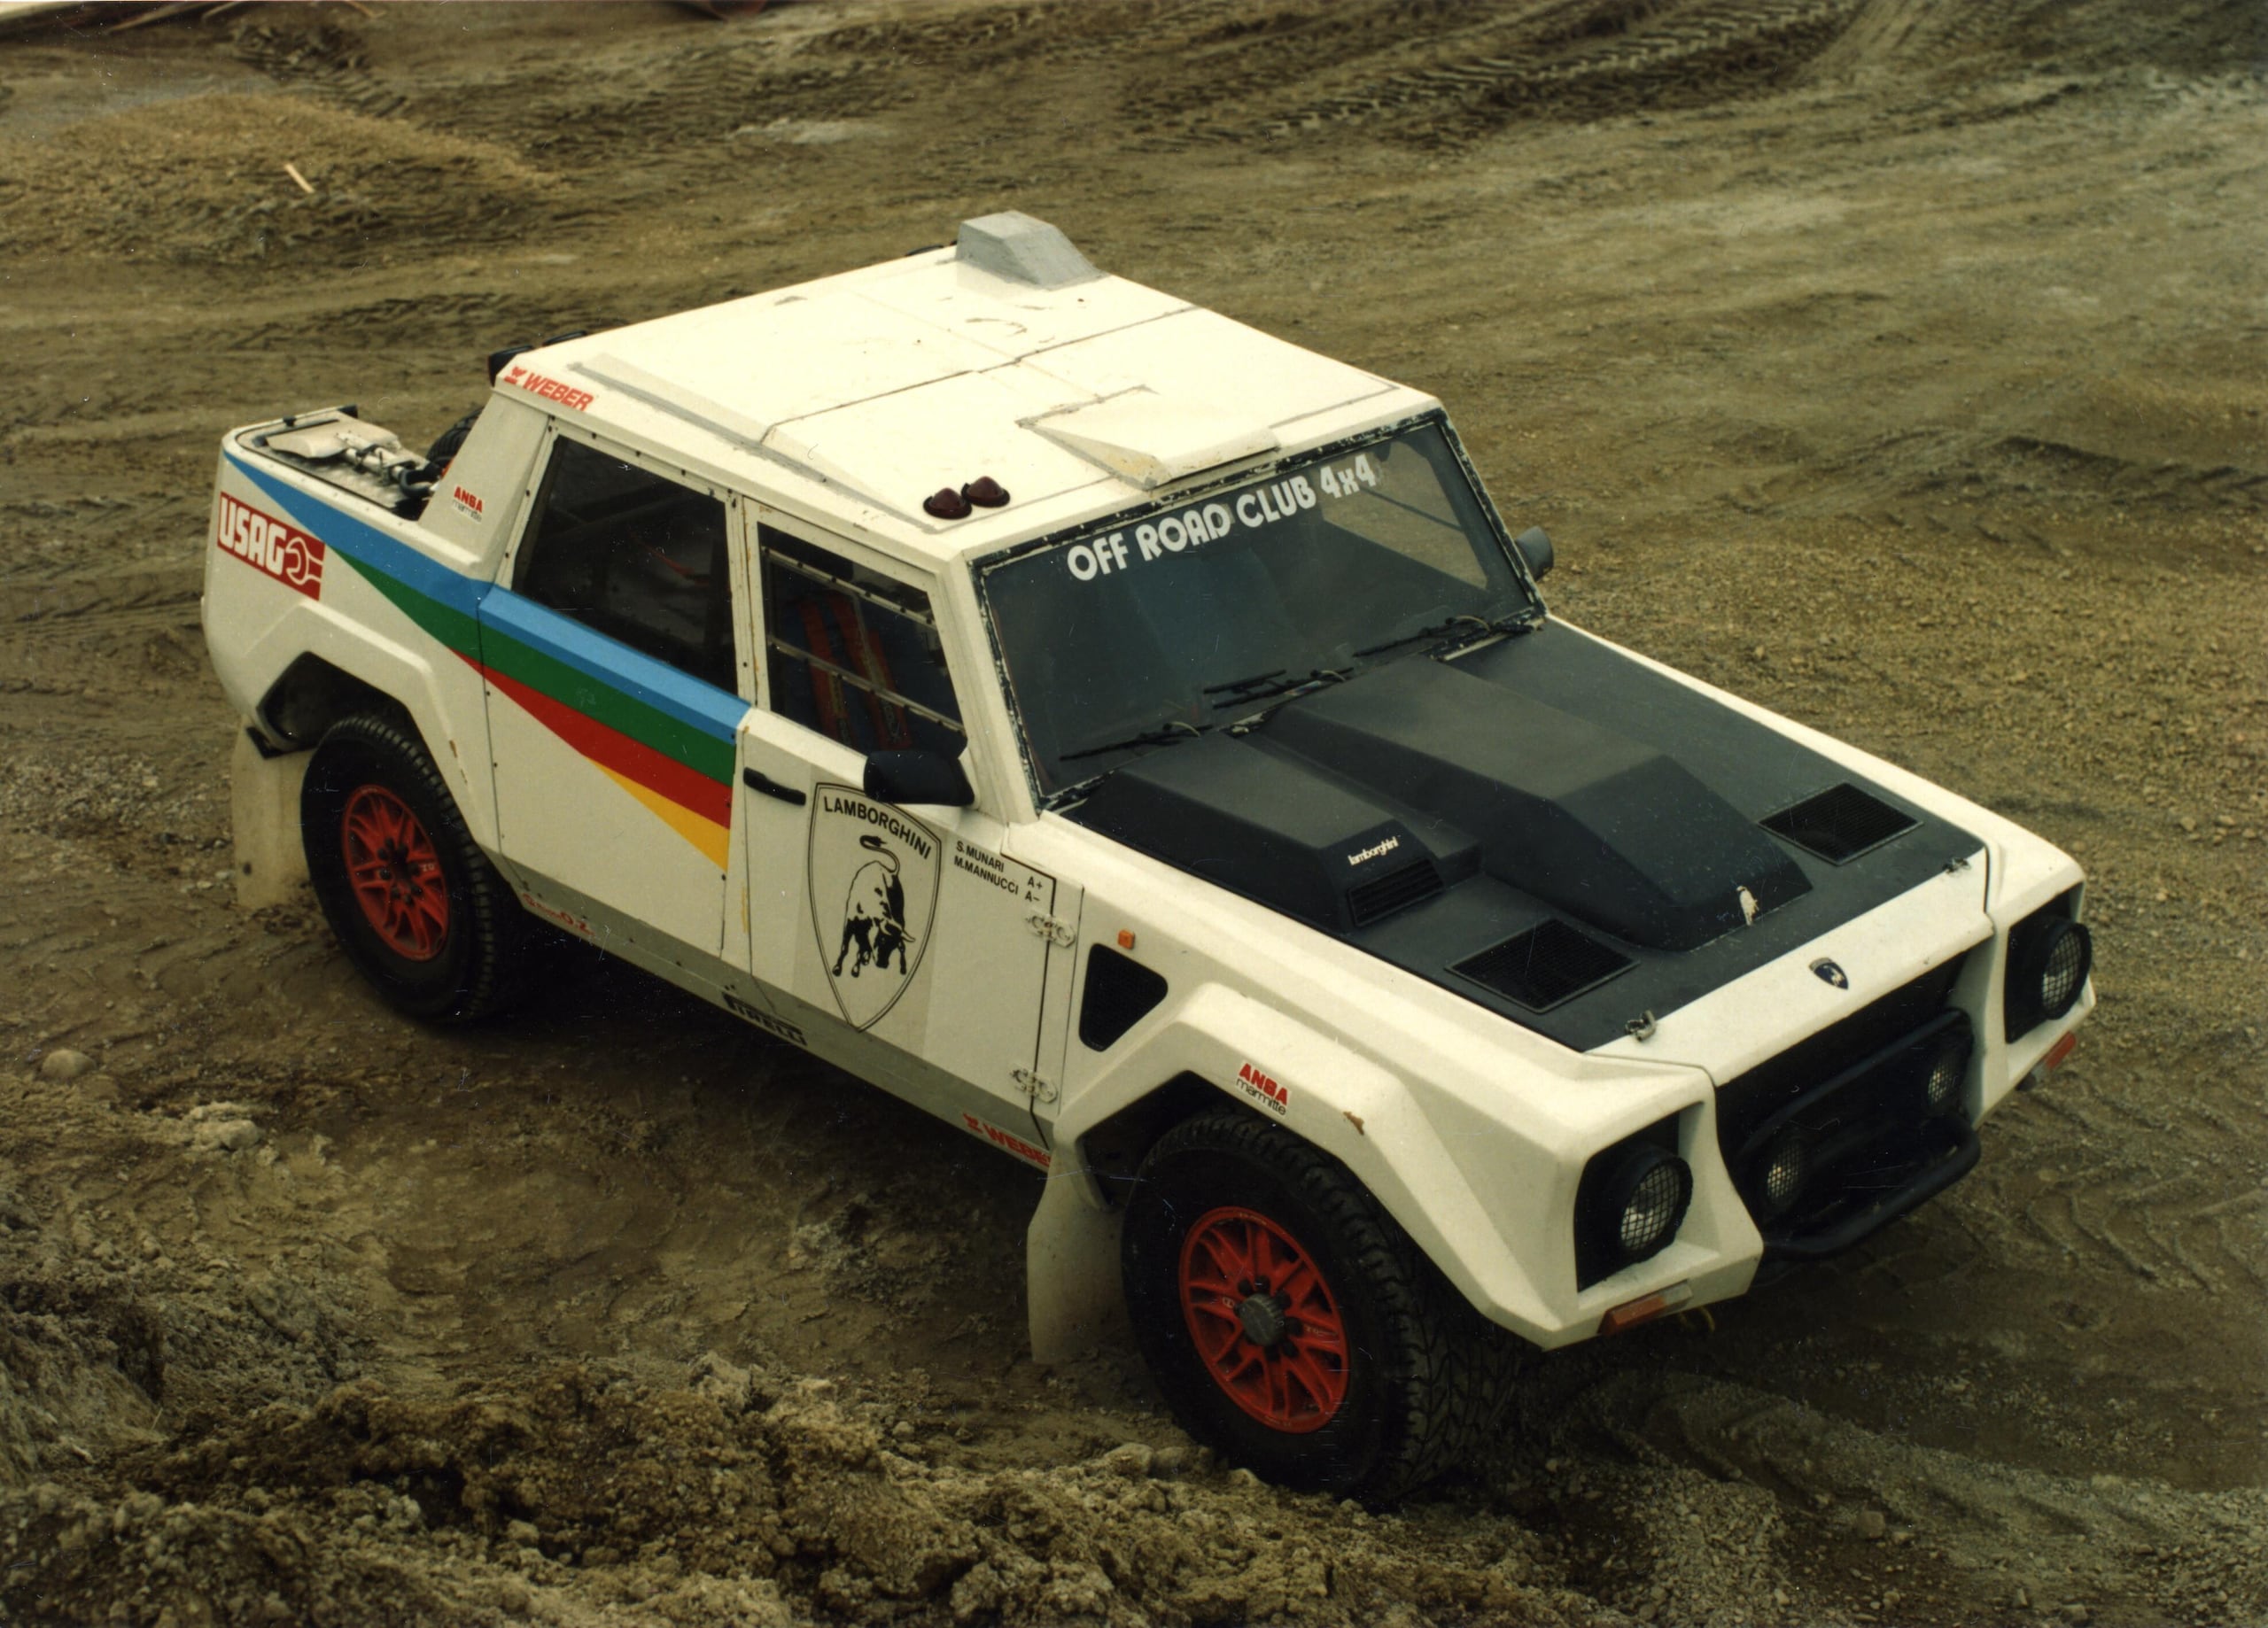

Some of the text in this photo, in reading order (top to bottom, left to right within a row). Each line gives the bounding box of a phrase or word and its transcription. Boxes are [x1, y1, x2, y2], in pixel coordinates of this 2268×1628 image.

[523, 371, 594, 412] WEBER
[219, 496, 287, 576] USAG
[1067, 532, 1129, 581] OFF
[1135, 503, 1231, 562] ROAD
[1237, 476, 1317, 528] CLUB
[824, 796, 932, 859] LAMBORGHINI
[1235, 1077, 1286, 1116] marmitte
[1239, 1062, 1288, 1106] ANSA
[983, 1120, 1052, 1167] WEBE
